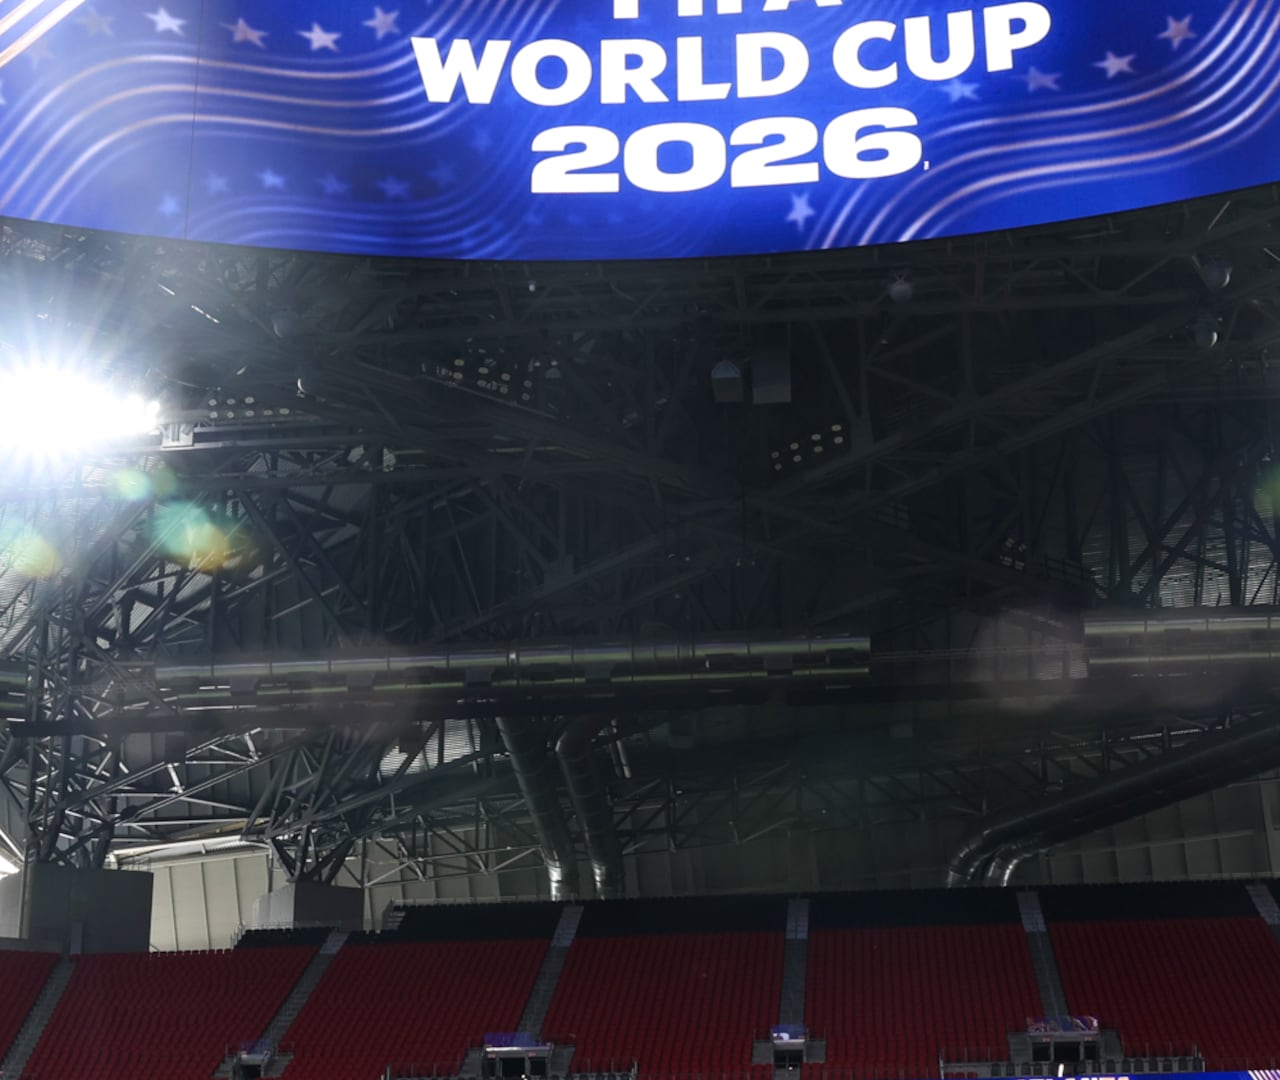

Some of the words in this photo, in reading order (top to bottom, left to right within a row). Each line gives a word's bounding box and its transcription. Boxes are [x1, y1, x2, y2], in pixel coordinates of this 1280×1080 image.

[410, 32, 810, 106] WORLD
[832, 1, 1051, 88] CUP
[530, 107, 923, 193] 2026
